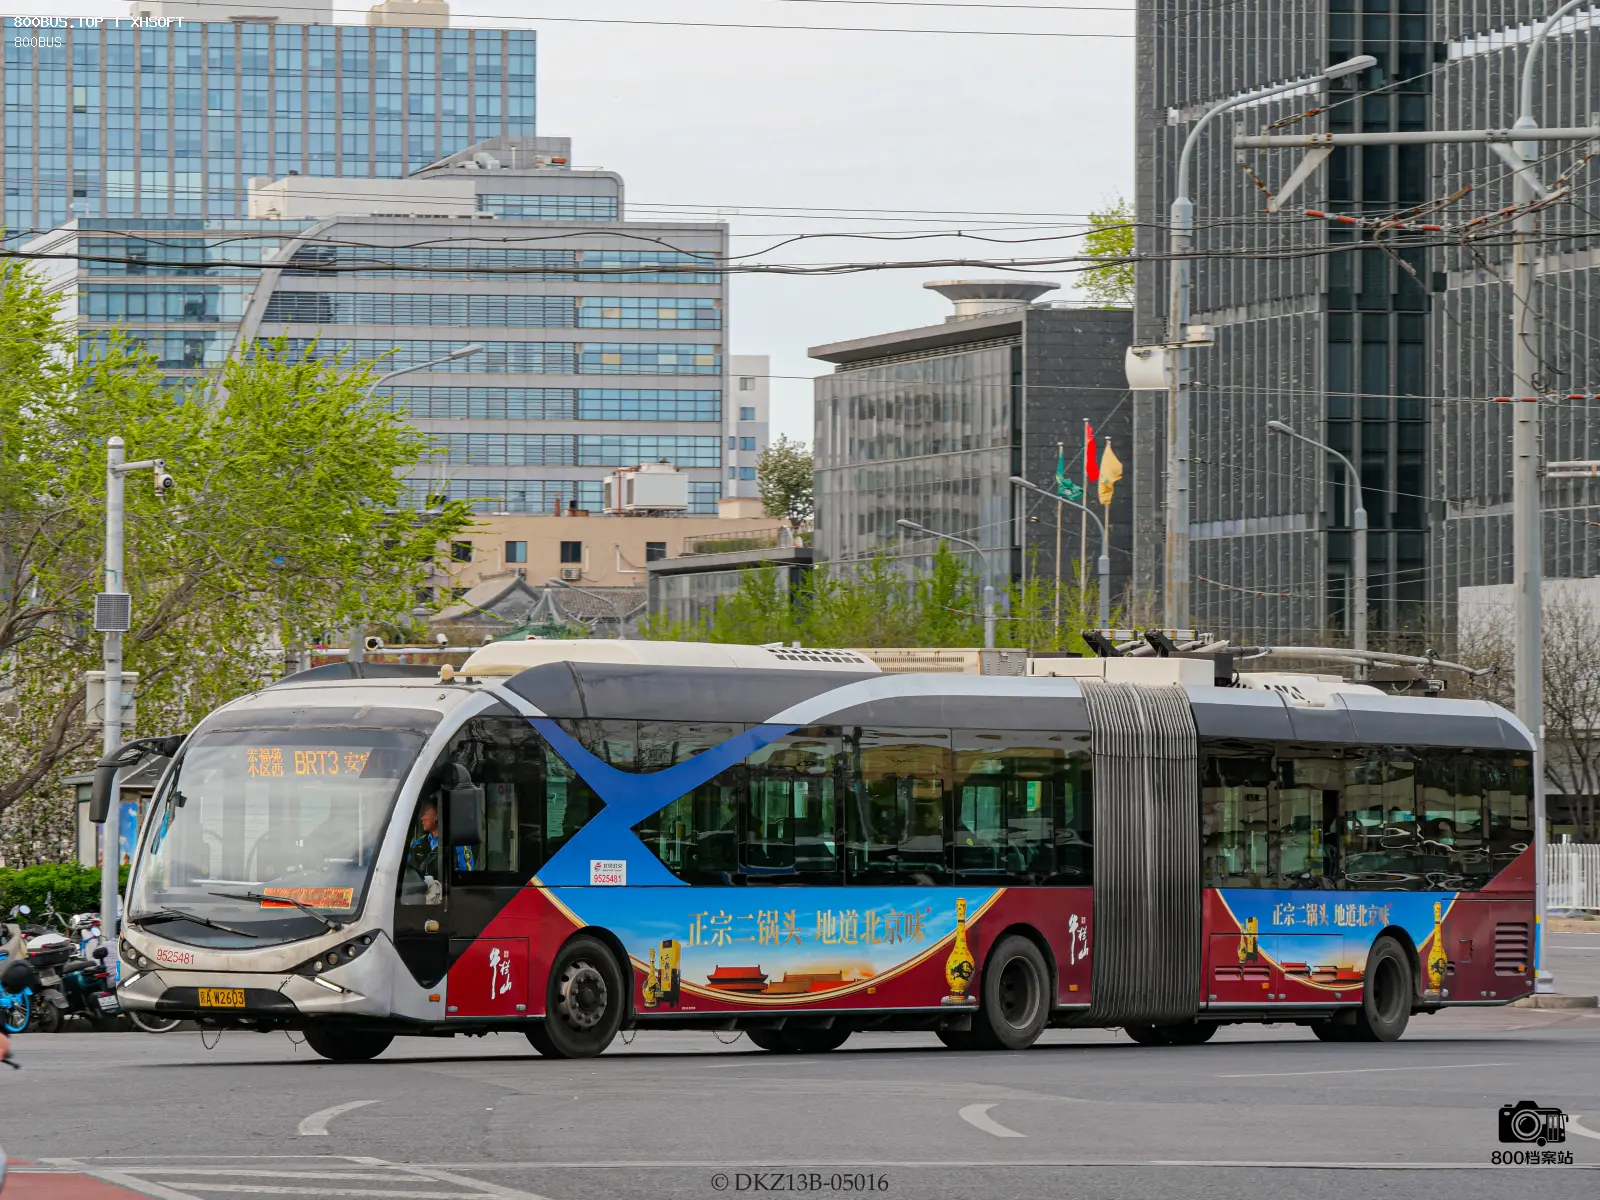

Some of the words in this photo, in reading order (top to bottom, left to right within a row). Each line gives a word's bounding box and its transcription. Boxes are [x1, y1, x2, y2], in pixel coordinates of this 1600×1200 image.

[294, 750, 339, 775] BRT3
[593, 874, 622, 883] 9525481
[1273, 903, 1329, 926] 正宗二锅头
[1334, 903, 1390, 927] 地道北京味
[687, 909, 802, 947] 正宗二锅头
[814, 909, 926, 946] 地道北京味
[156, 949, 195, 965] 9525481
